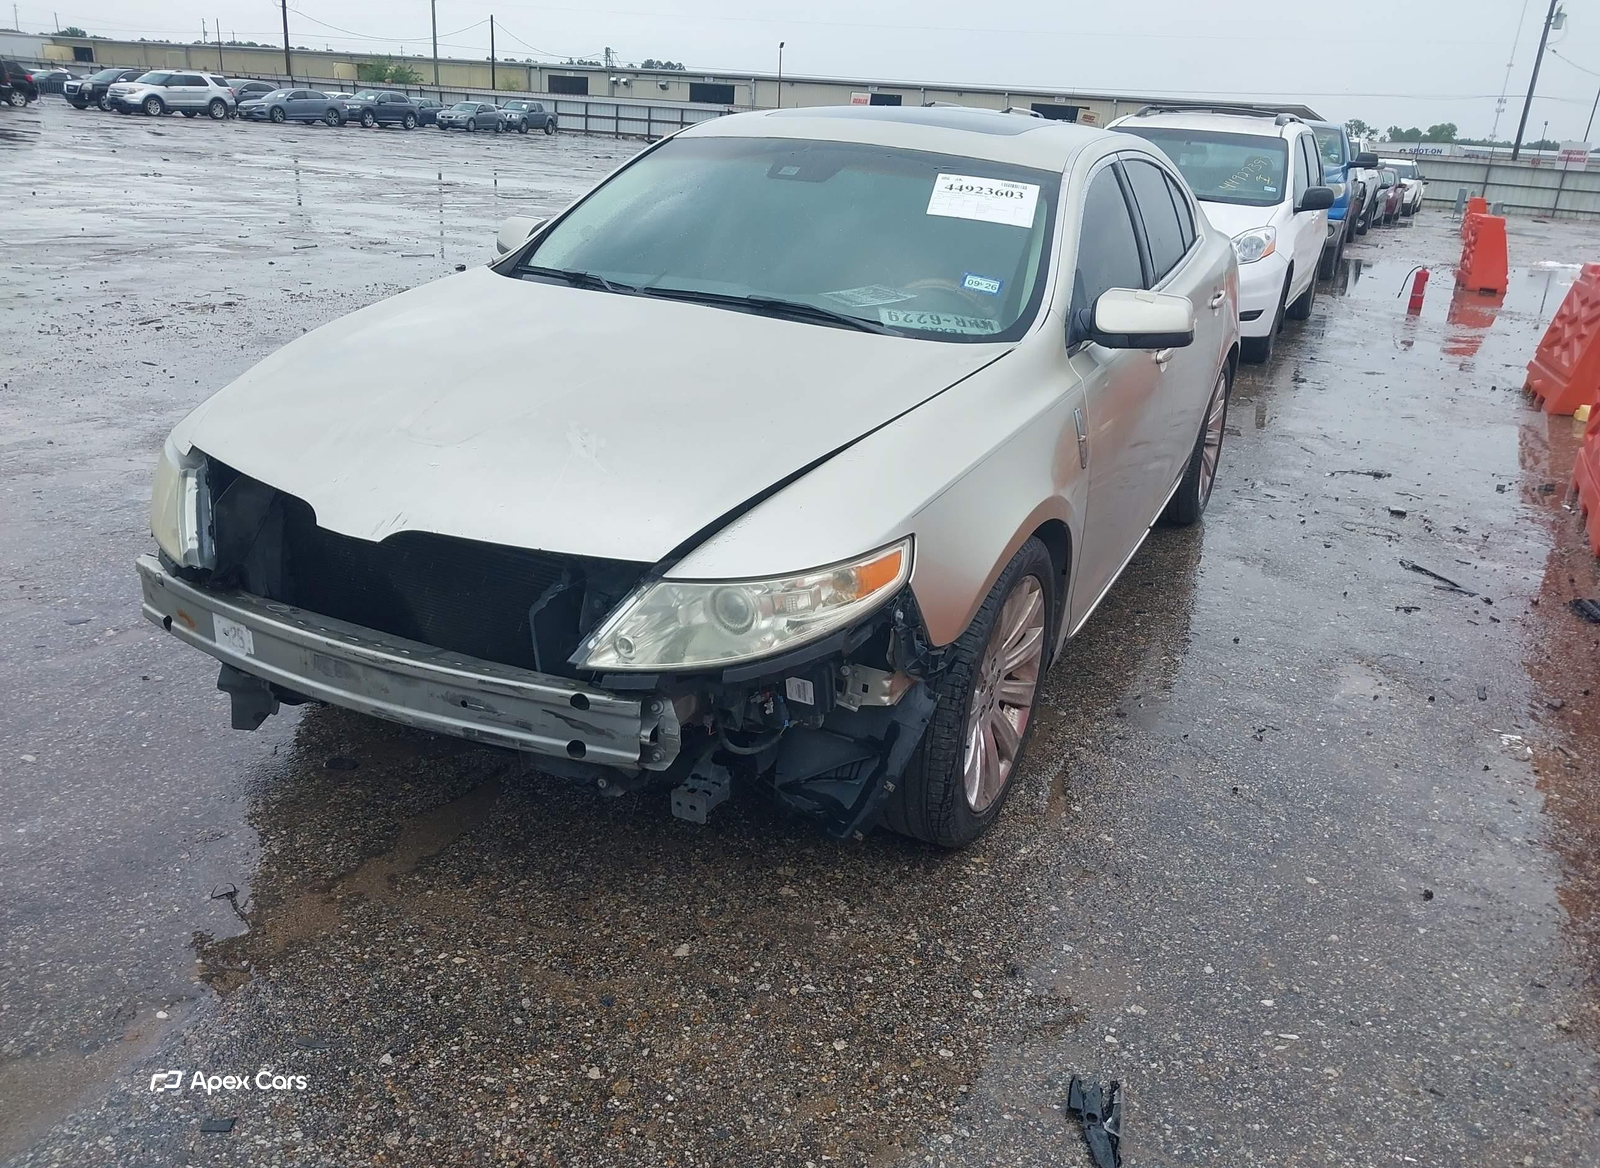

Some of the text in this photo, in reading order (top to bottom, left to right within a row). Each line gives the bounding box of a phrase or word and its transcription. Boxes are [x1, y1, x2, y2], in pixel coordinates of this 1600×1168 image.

[944, 183, 1024, 199] 44923603
[967, 278, 998, 291] 09 26
